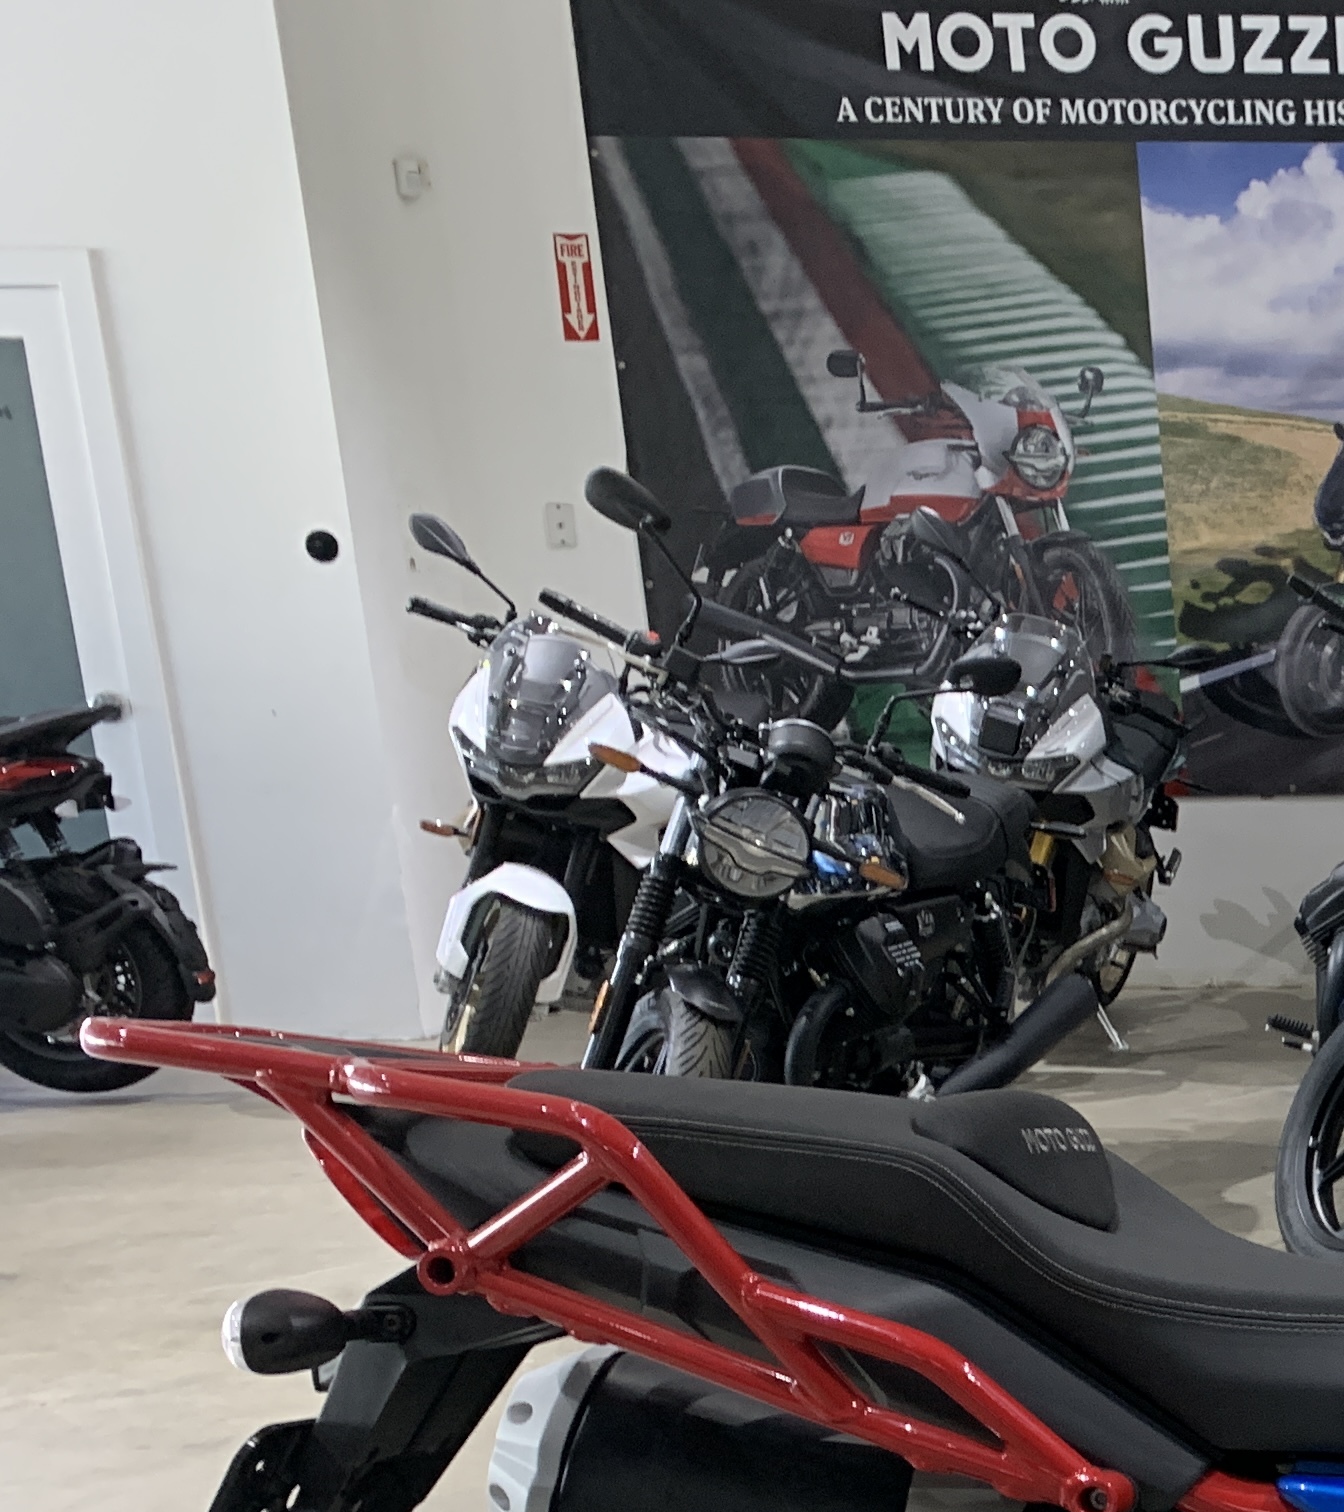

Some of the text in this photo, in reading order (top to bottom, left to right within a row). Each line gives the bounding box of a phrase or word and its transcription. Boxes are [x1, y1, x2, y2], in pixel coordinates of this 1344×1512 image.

[881, 12, 1096, 73] MOTO
[836, 96, 858, 123] A
[864, 96, 1004, 125] CENTURY
[1012, 97, 1052, 125] OF
[1059, 98, 1297, 126] MOTORCYCLING
[560, 243, 584, 258] FIRE
